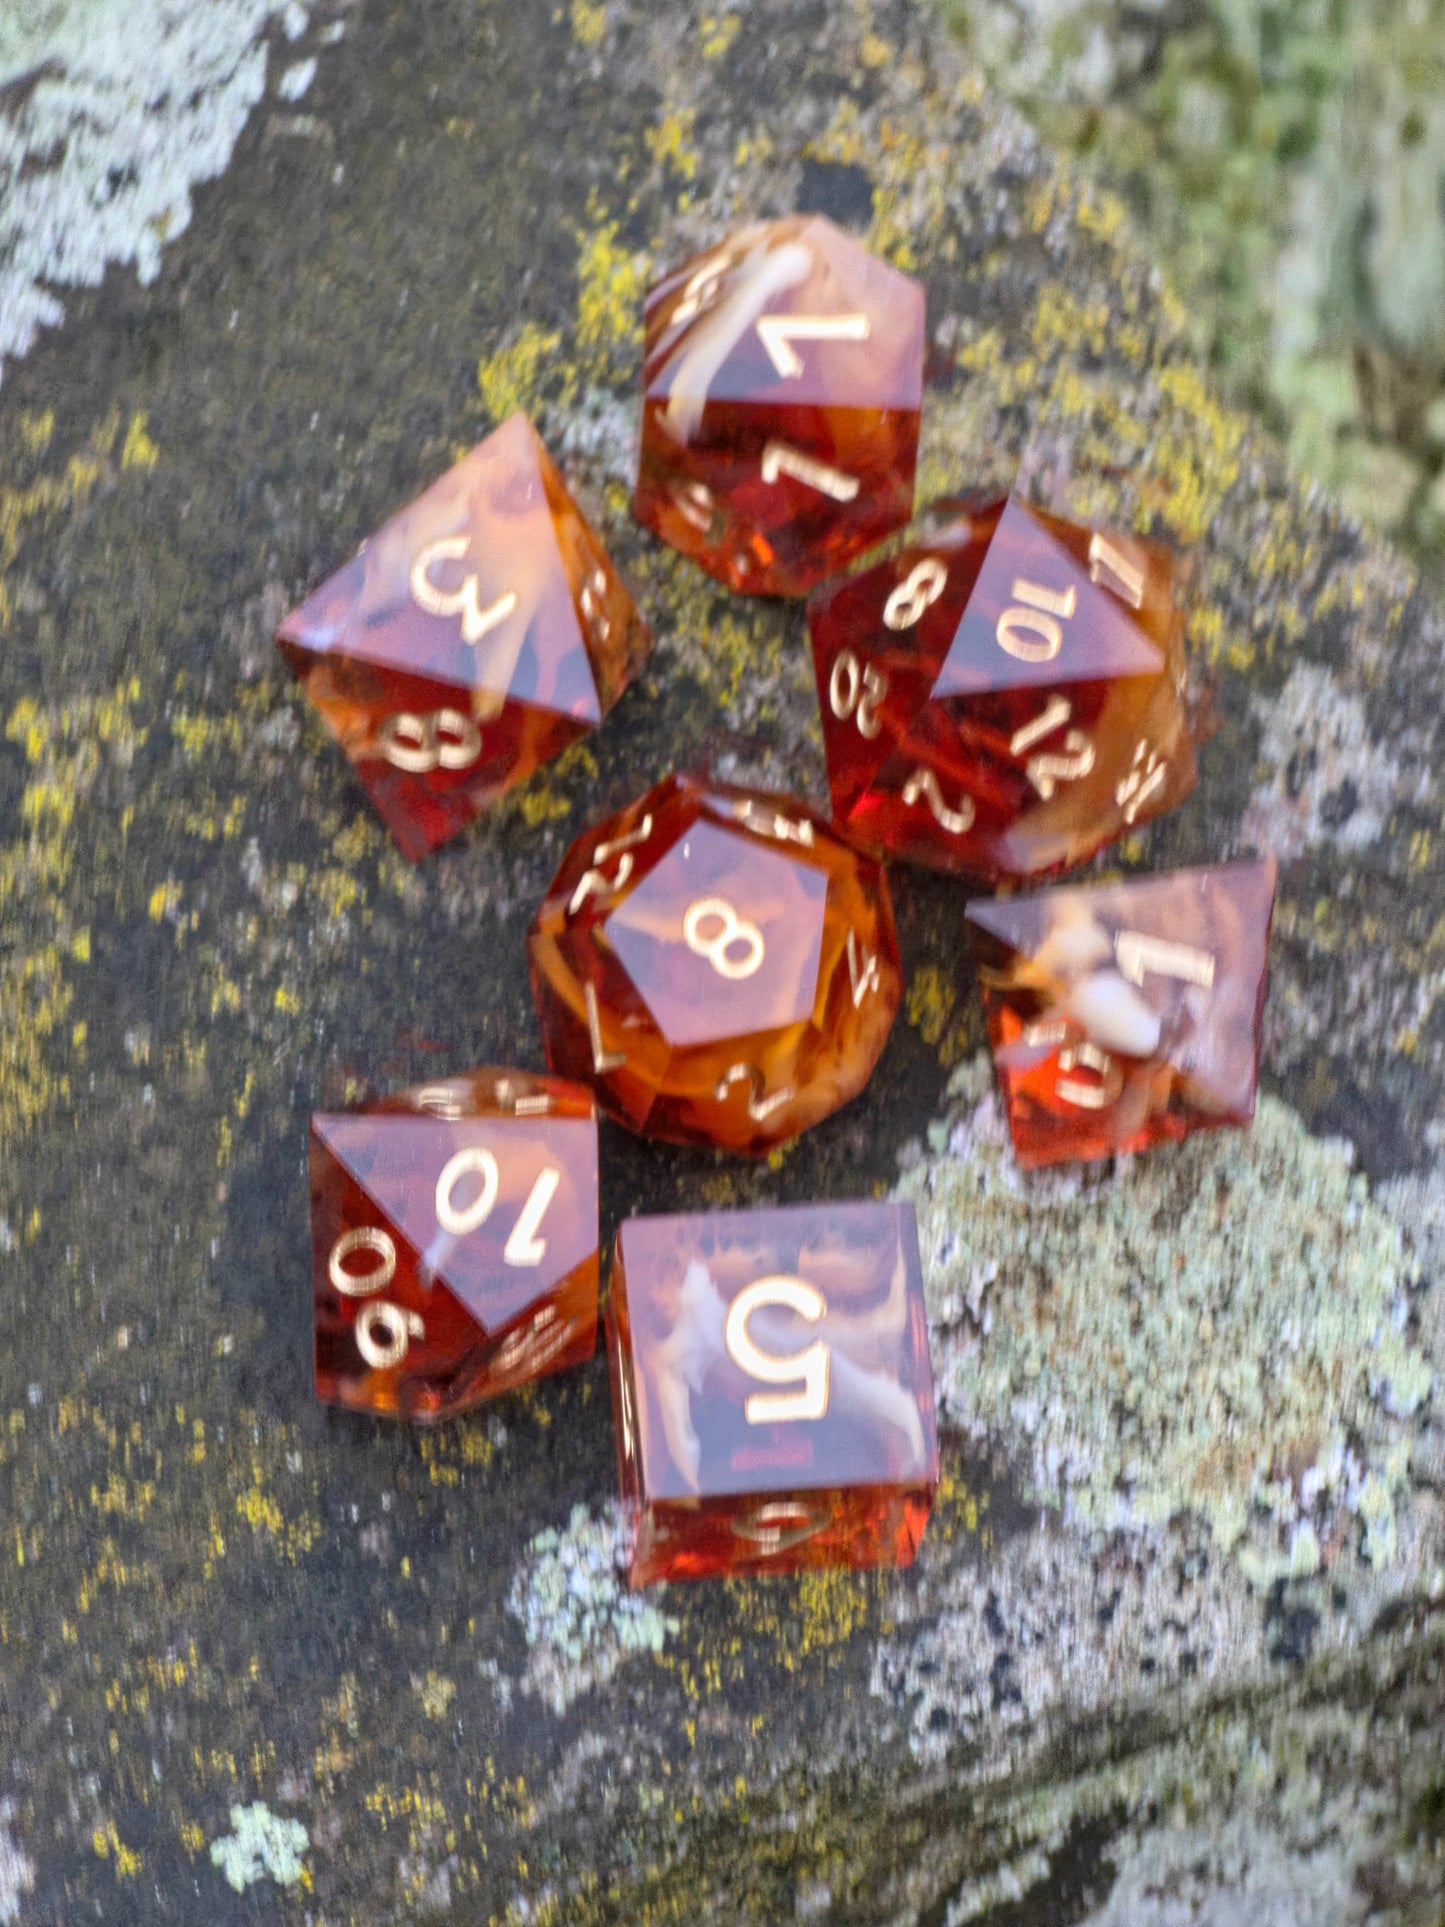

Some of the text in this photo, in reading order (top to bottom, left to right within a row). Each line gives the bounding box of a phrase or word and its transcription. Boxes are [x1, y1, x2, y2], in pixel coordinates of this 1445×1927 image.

[409, 536, 517, 646] 3
[882, 557, 949, 631] 8
[995, 577, 1077, 663] 10
[377, 707, 483, 774] 8
[1009, 694, 1096, 801] 12
[903, 768, 976, 835] 2
[683, 896, 766, 981] 8
[435, 1147, 561, 1268] 10
[724, 1274, 830, 1426] 5
